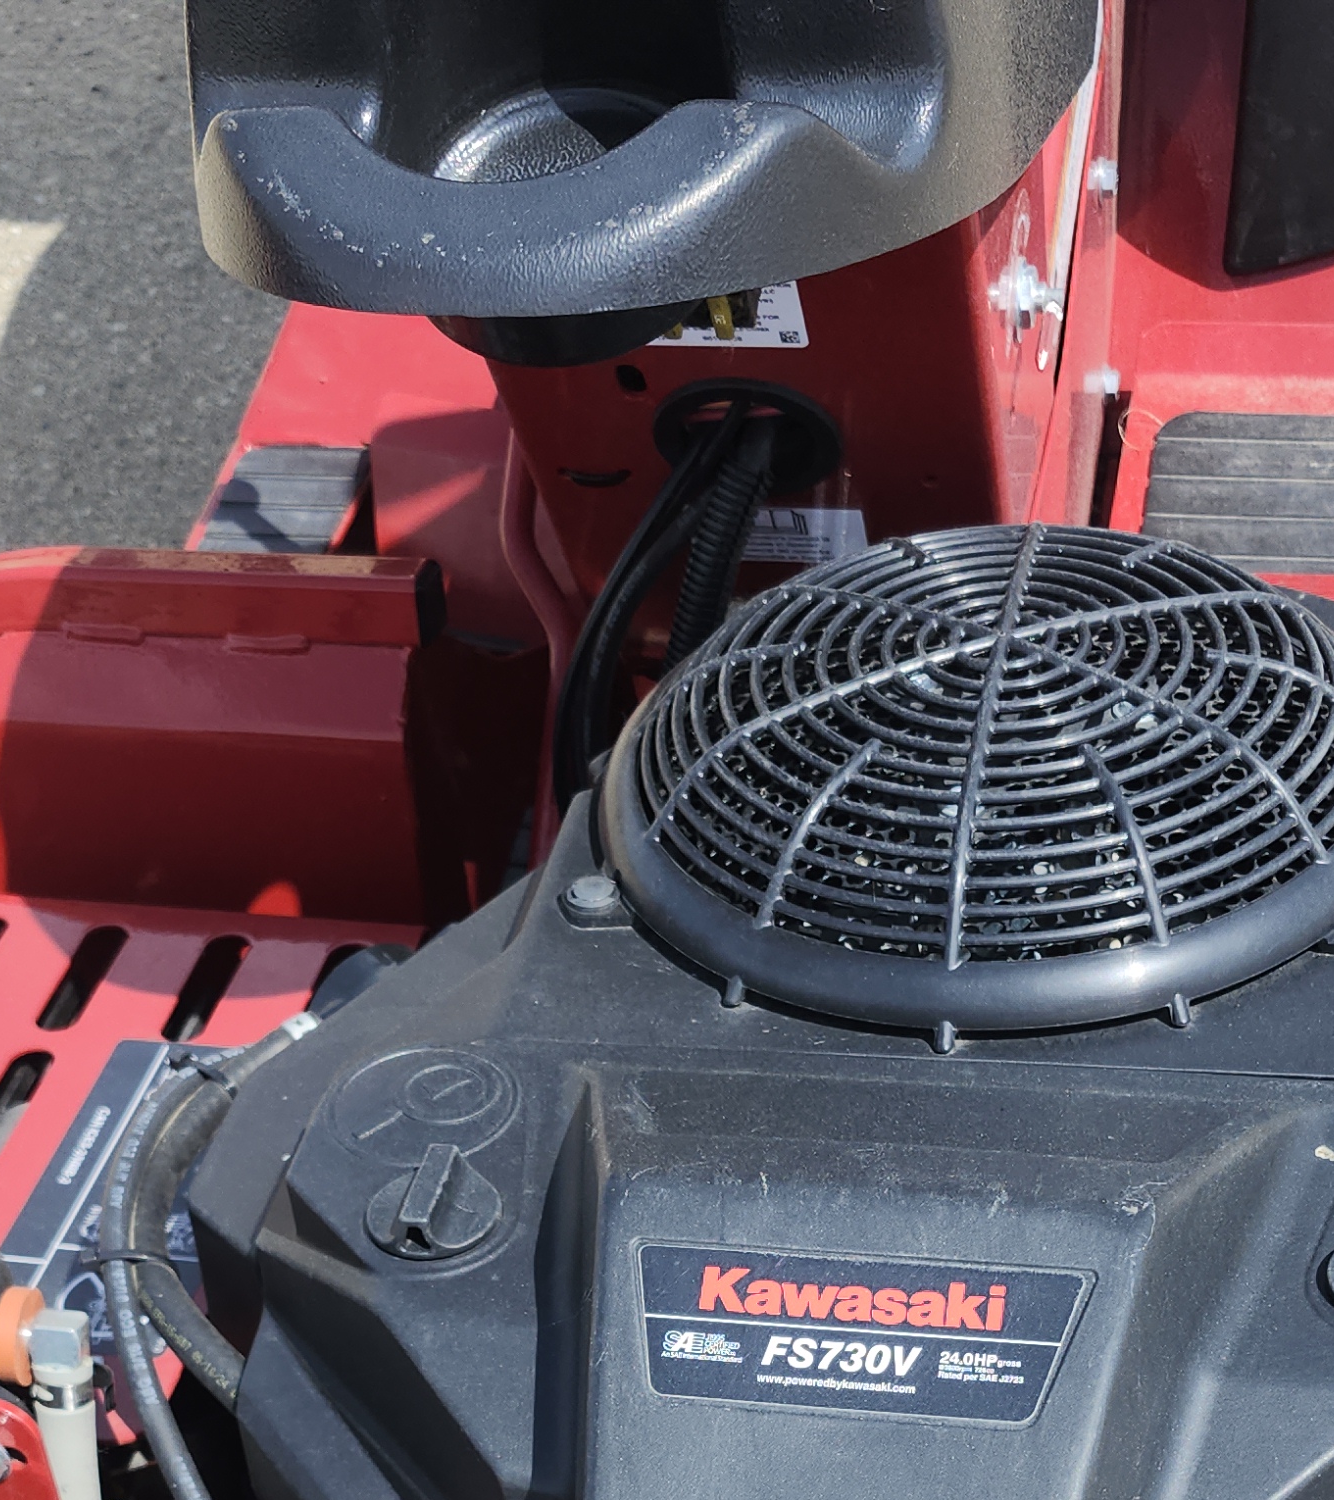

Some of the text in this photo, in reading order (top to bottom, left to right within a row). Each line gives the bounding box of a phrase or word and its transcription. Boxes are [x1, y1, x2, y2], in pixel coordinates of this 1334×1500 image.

[698, 1265, 1007, 1331] Kawasaki
[662, 1330, 706, 1353] SAE
[760, 1335, 923, 1377] FS730V
[756, 1374, 916, 1394] www.poweredbykawasaki.com
[937, 1370, 1024, 1384] Rated per SAE J2723
